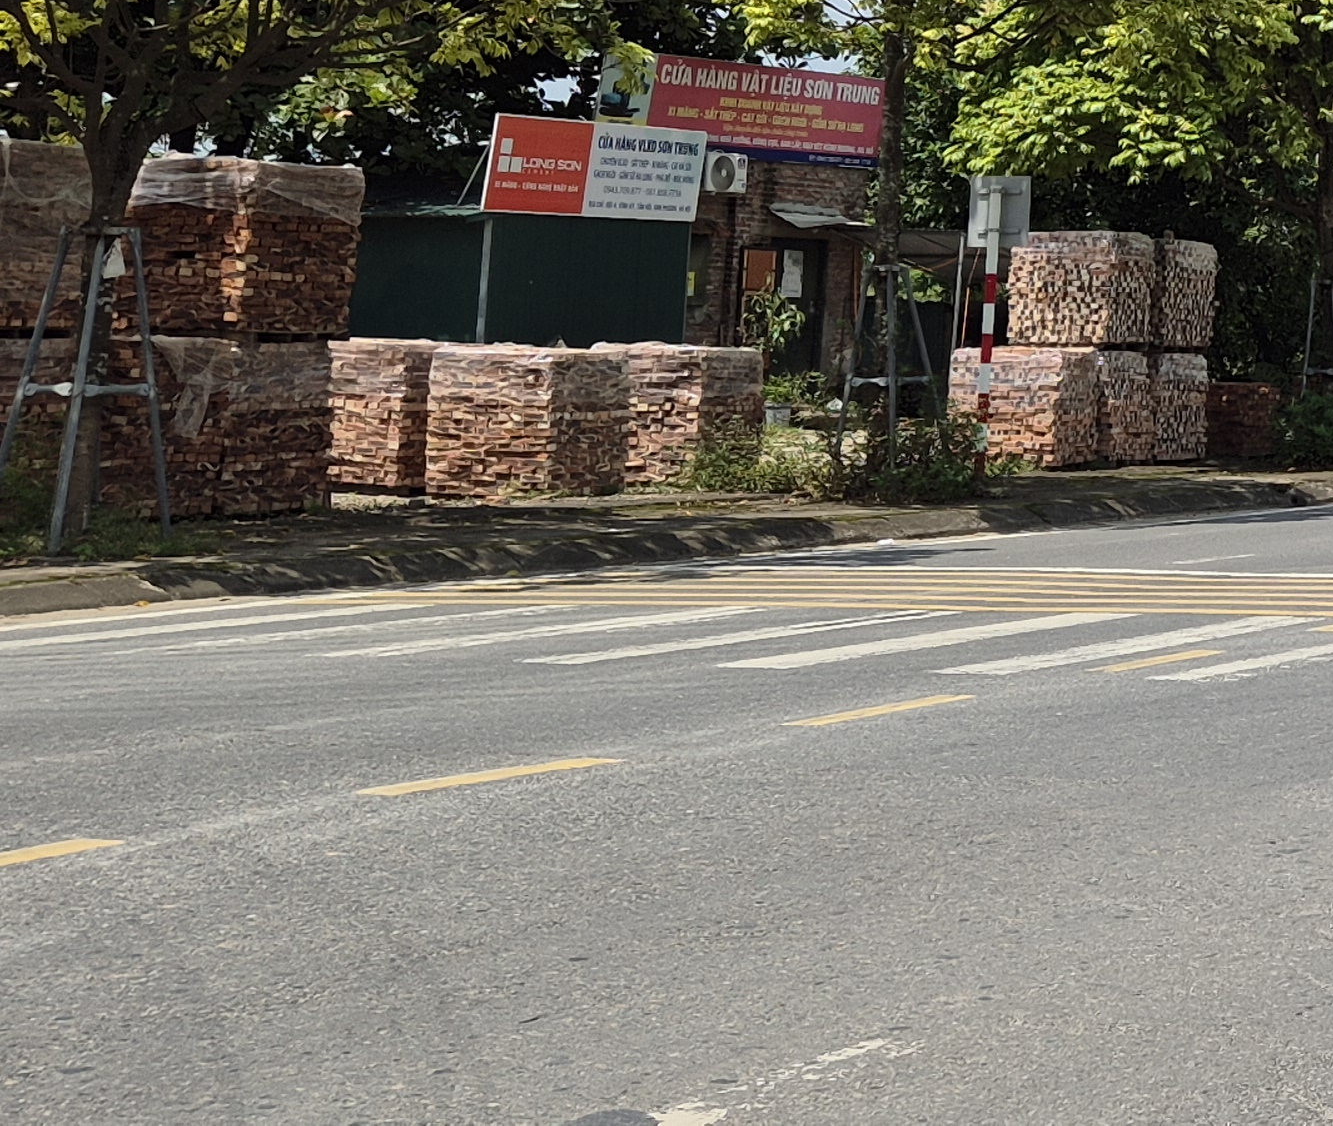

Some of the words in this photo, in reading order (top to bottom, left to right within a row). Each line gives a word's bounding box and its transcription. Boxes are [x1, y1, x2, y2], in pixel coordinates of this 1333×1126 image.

[660, 58, 693, 87] CỬA
[695, 64, 739, 91] HÀNG
[741, 69, 770, 98] VẬT
[769, 73, 803, 100] LIỆU
[803, 78, 834, 101] SƠN
[835, 82, 881, 105] TRUNG
[598, 131, 614, 150] CỬA
[614, 134, 637, 152] HÀNG
[522, 157, 556, 170] LONG
